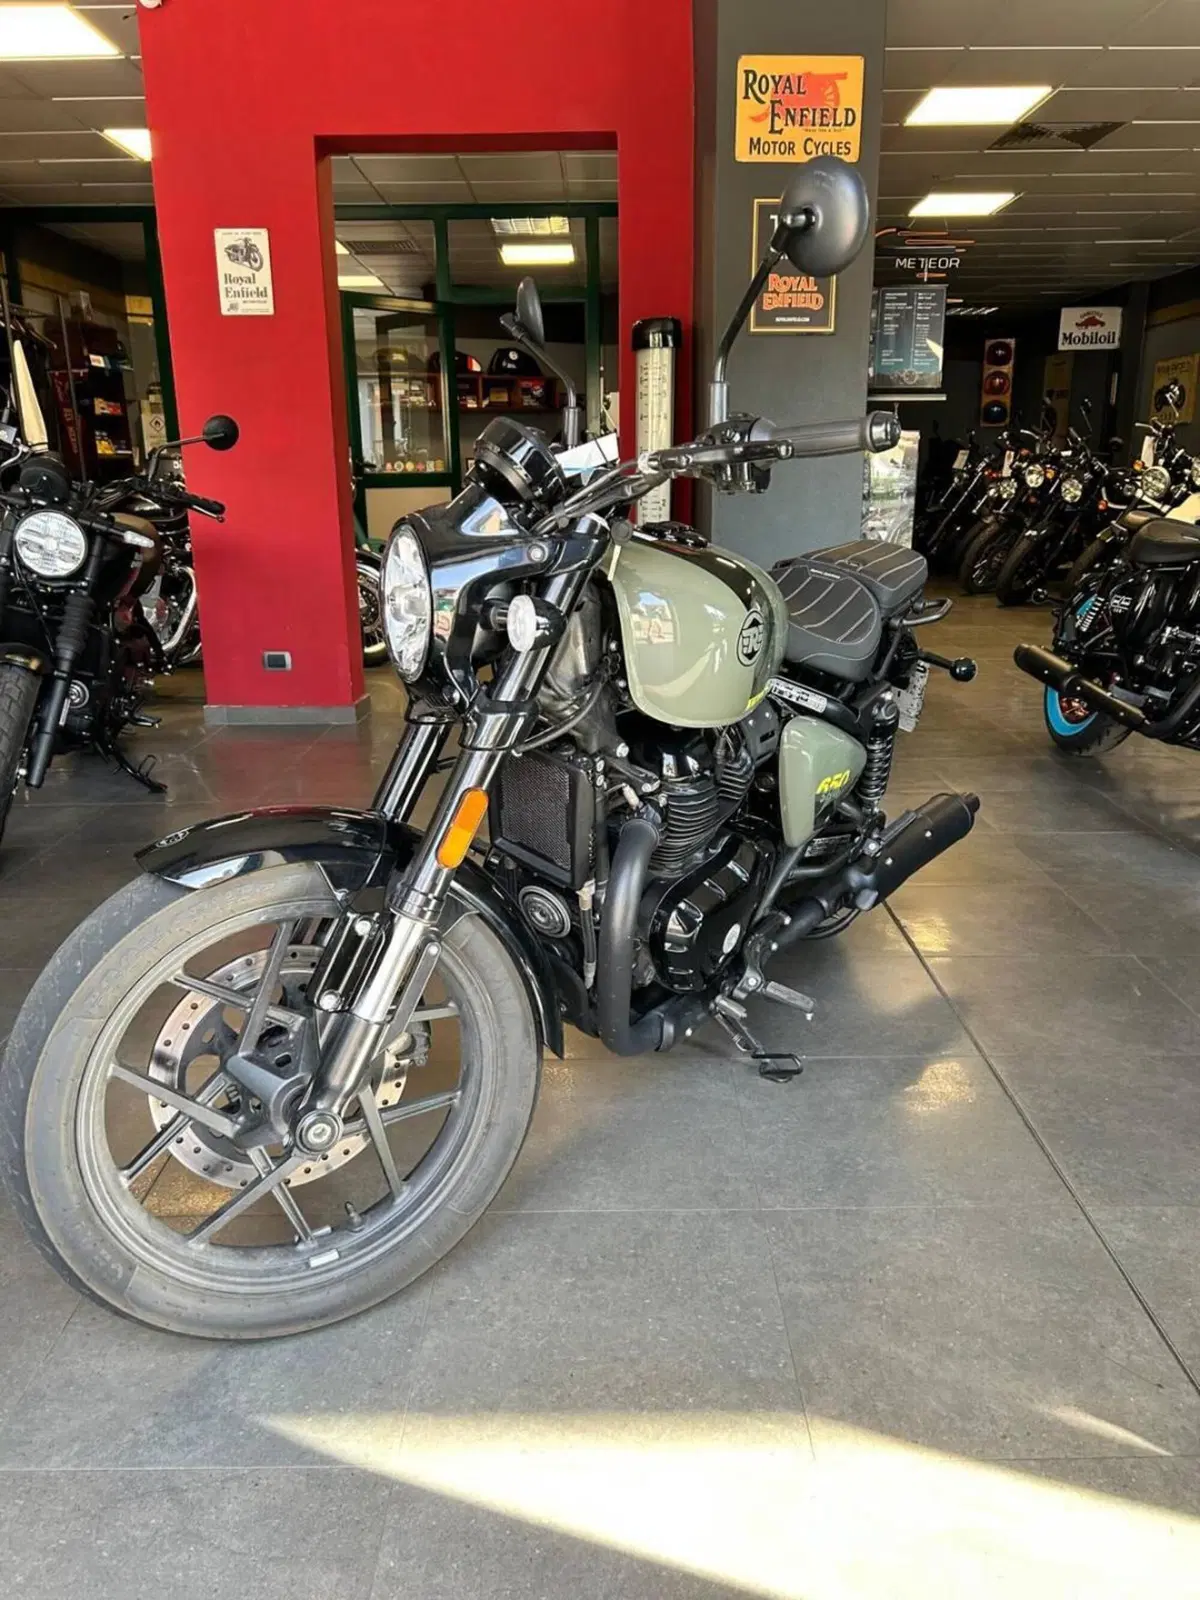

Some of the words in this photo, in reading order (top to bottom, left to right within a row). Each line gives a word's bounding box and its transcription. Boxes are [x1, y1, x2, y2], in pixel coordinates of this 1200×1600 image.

[742, 69, 807, 104] ROYAL
[768, 99, 856, 135] ENFIELD
[749, 137, 796, 155] MOTOR
[803, 137, 852, 156] CYCLES
[895, 257, 960, 269] METEOR
[224, 273, 256, 285] Royal
[768, 273, 818, 292] ROYAL
[225, 286, 268, 299] Enfield
[762, 292, 824, 311] ENFIELD
[1061, 331, 1116, 346] Mobiloil
